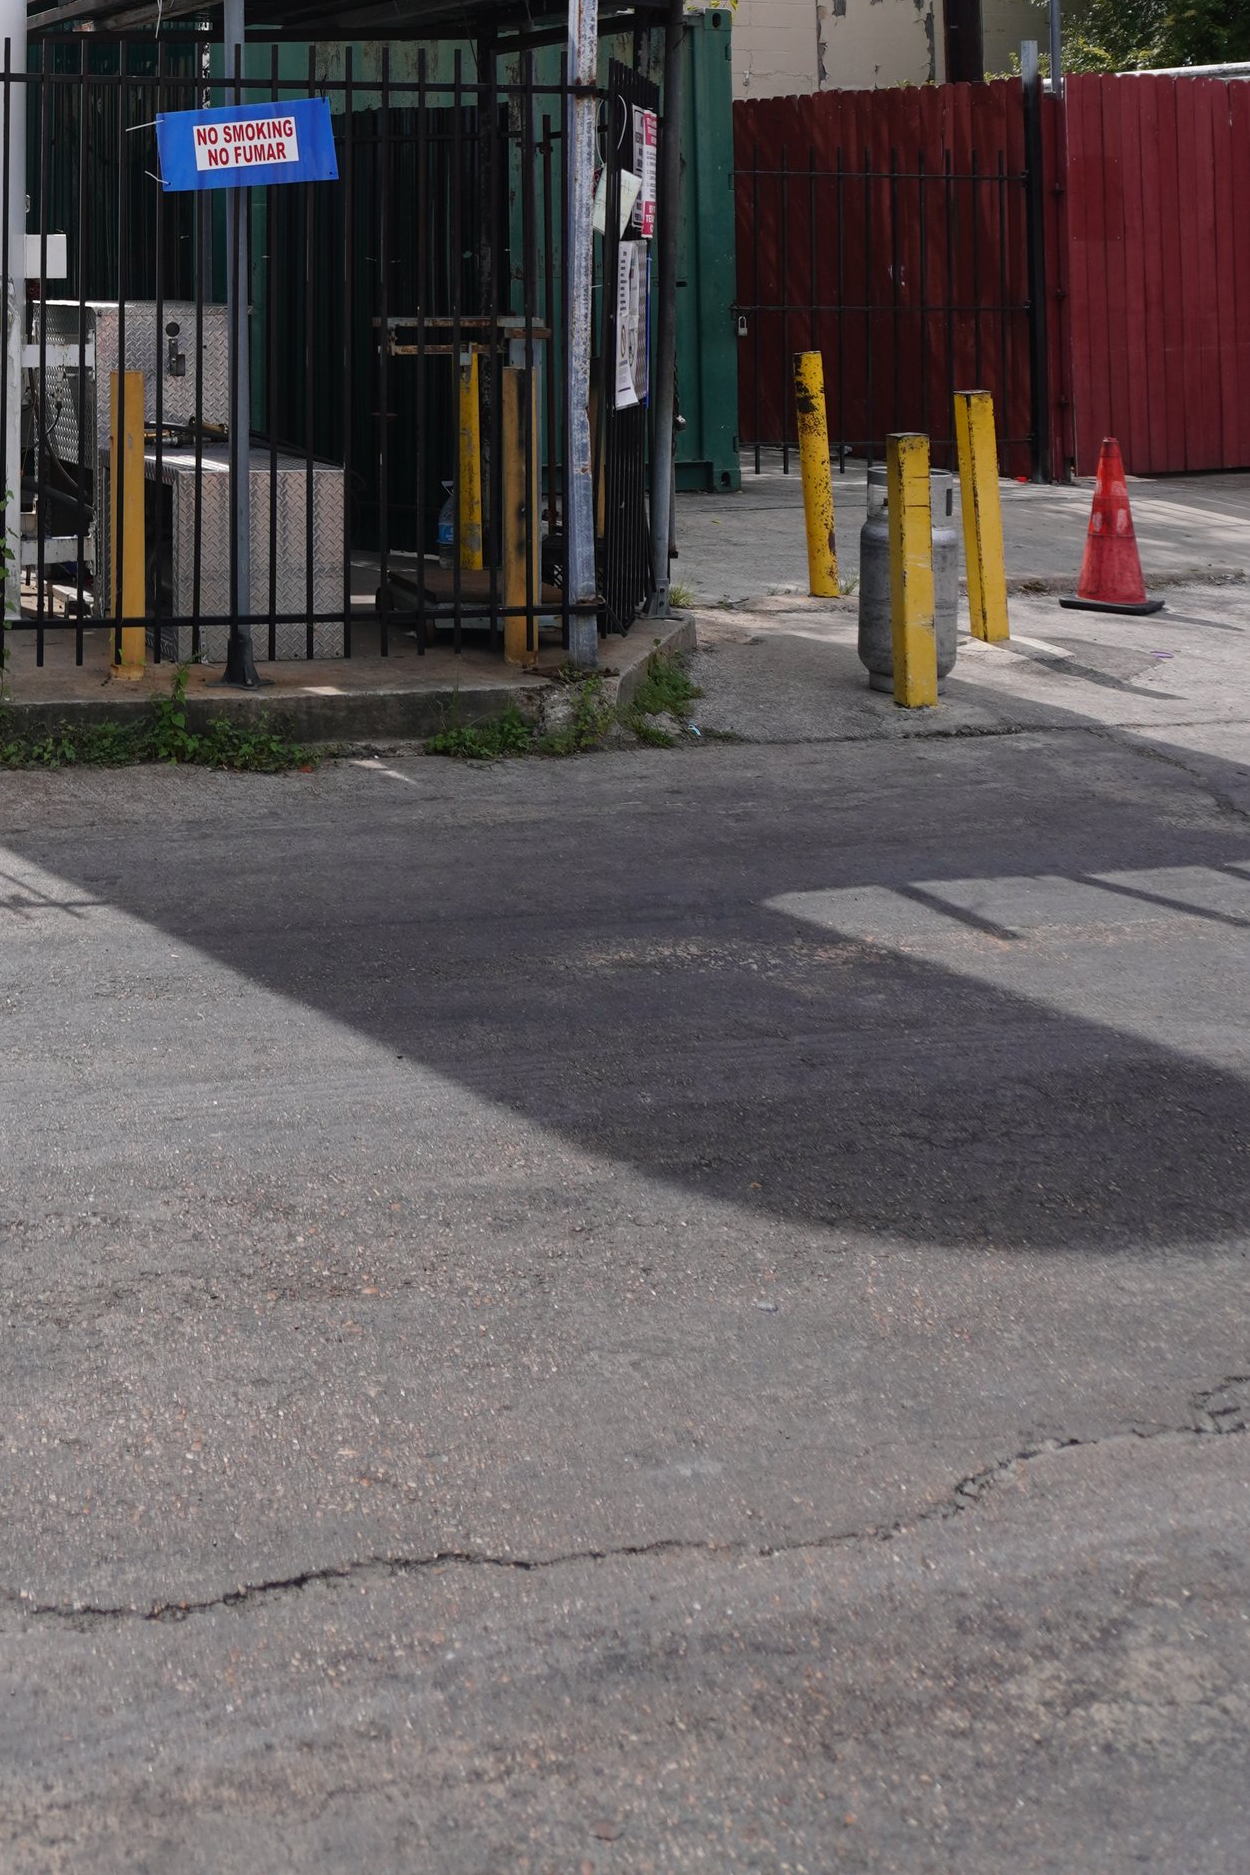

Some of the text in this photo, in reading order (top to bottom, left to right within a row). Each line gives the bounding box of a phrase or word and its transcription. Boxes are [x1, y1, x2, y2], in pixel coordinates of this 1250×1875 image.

[196, 119, 293, 146] NO SMOKING
[207, 142, 286, 167] NO FUMAR
